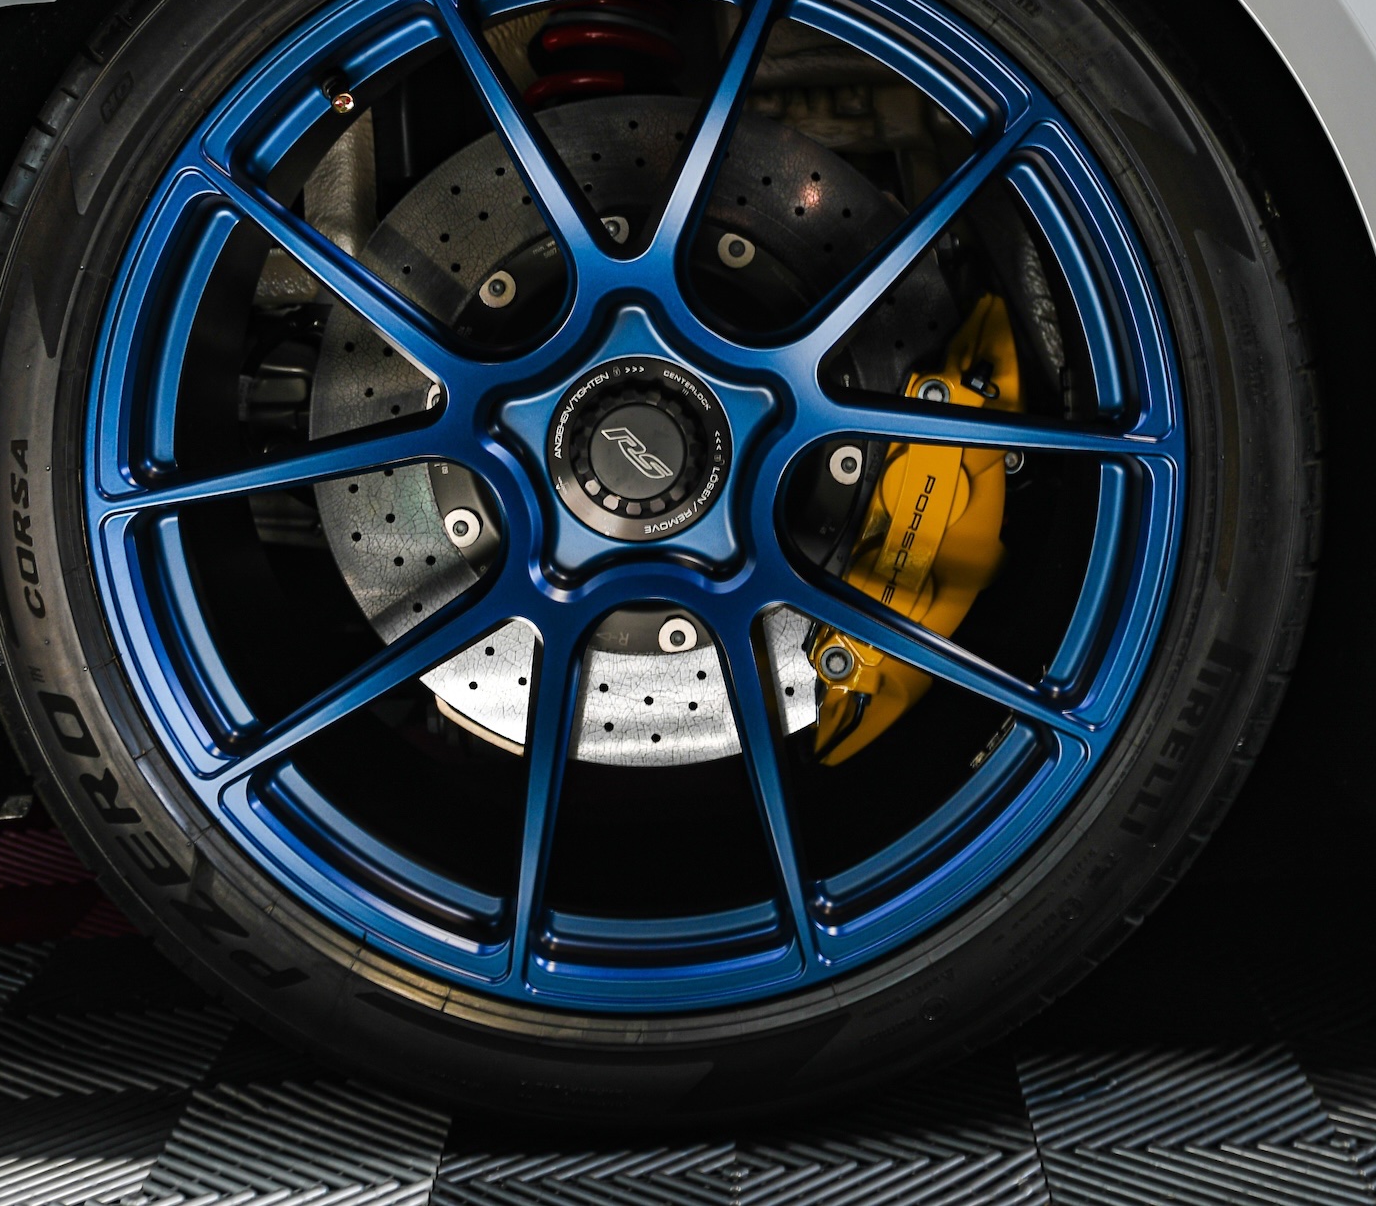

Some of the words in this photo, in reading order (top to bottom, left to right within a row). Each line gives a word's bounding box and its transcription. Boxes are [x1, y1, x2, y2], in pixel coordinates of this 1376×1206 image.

[663, 369, 711, 411] CENTERLOCK
[601, 427, 674, 479] RS
[12, 439, 48, 620] CORSA
[644, 508, 693, 534] REMOVE
[880, 475, 936, 605] PORSCHE
[1118, 638, 1254, 846] PIRELLI
